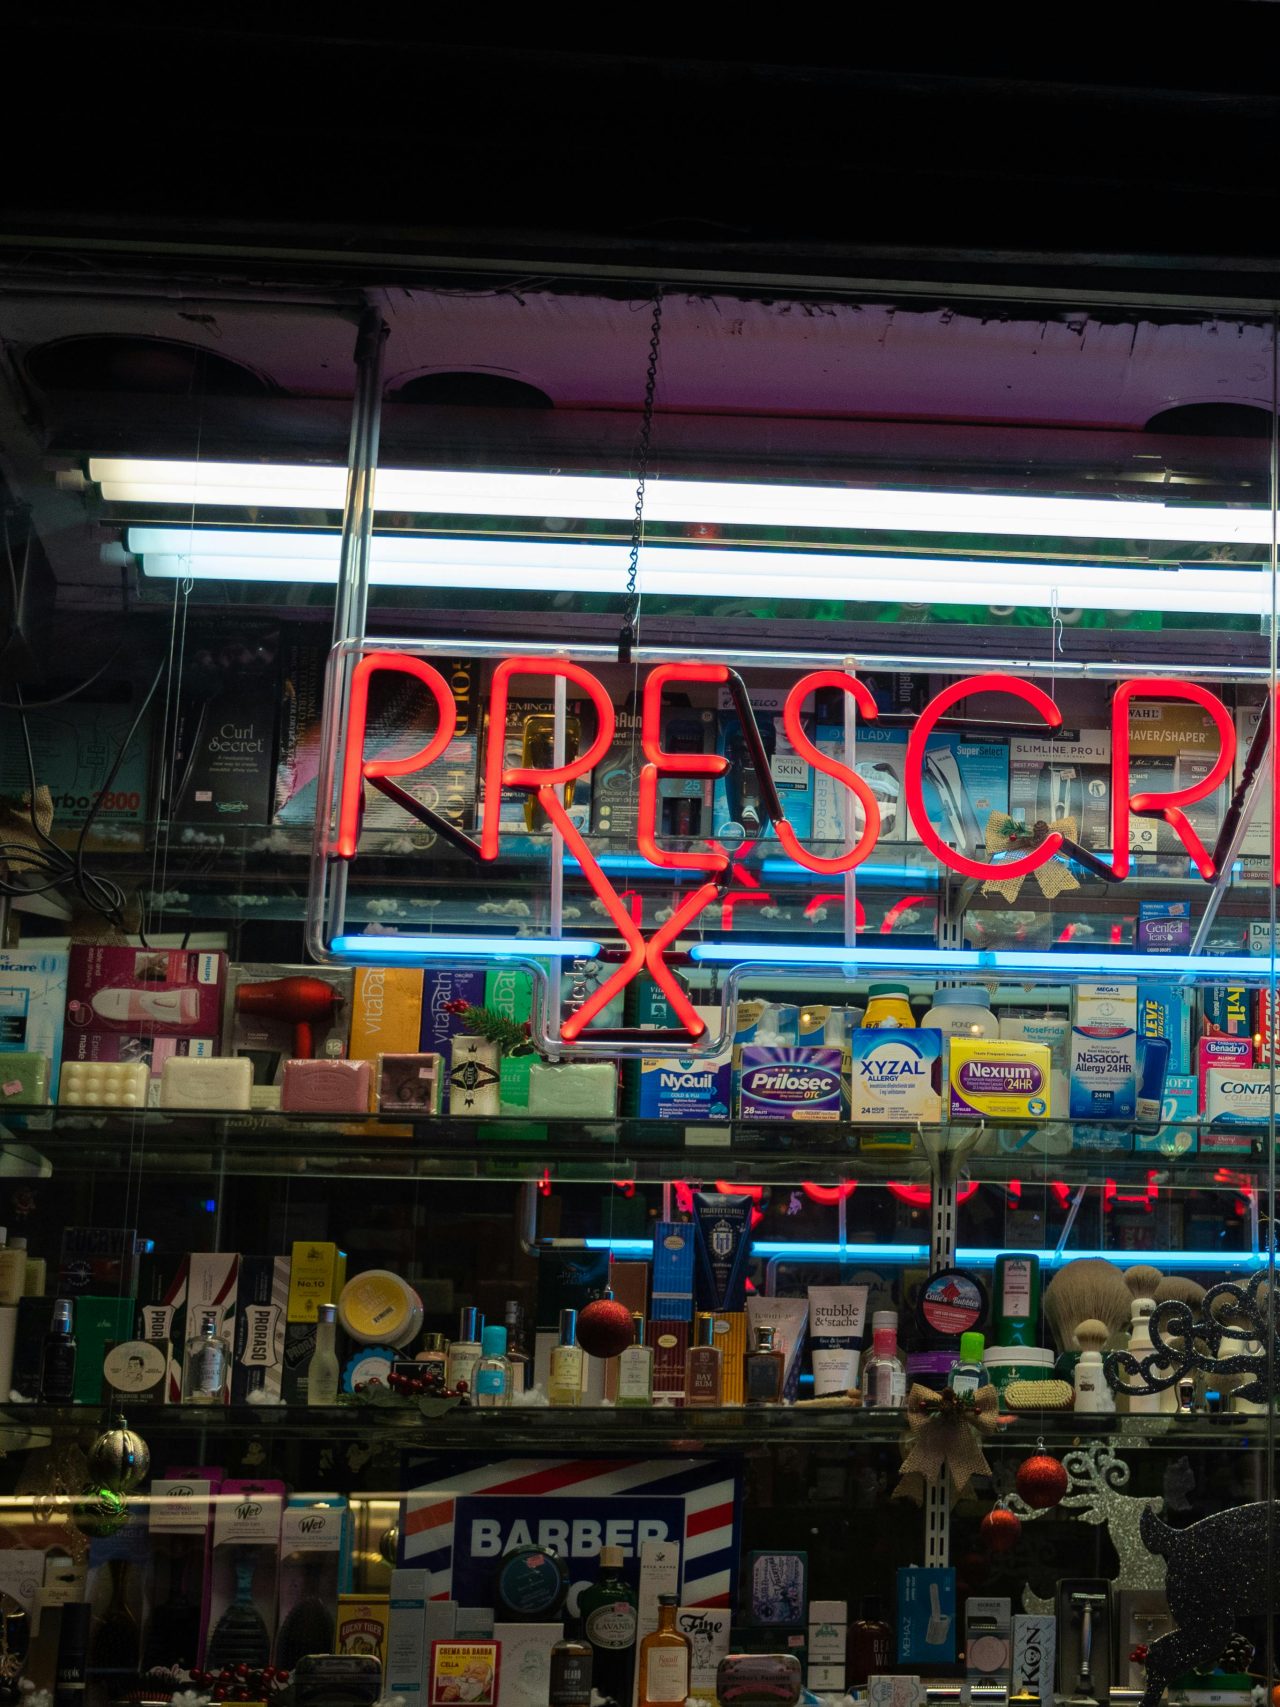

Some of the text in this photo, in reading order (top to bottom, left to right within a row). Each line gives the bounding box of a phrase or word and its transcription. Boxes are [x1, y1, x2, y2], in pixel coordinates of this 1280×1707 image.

[220, 724, 253, 739] Curl
[208, 736, 263, 753] Secret
[956, 744, 1003, 757] SuperSelect
[1016, 745, 1066, 755] SLIMLINE
[1071, 747, 1093, 755] PRO
[777, 765, 803, 775] SKIN
[1145, 921, 1184, 934] GenTeal
[1147, 933, 1168, 941] Tears
[203, 955, 213, 982] PHILIPS
[362, 967, 385, 1035] vitabat
[432, 970, 453, 1045] vitabath
[1023, 1025, 1065, 1035] NoseFrida
[79, 1034, 87, 1059] made
[327, 1041, 342, 1052] 12
[1209, 1044, 1247, 1053] Benadryl
[1077, 1052, 1129, 1064] Nasacort
[860, 1060, 926, 1075] XYZAL
[969, 1063, 1031, 1079] Nexium
[1075, 1063, 1106, 1074] Allergy
[660, 1074, 713, 1091] NyQuil
[751, 1074, 833, 1090] Prilosec
[1007, 1079, 1033, 1090] 24HR
[804, 1091, 820, 1099] OTC
[744, 1106, 755, 1114] 28
[298, 1280, 325, 1288] No.10
[816, 1305, 859, 1317] stubble
[251, 1309, 268, 1362] PRORASO
[696, 1373, 712, 1381] BAY
[695, 1379, 713, 1388] RUM
[239, 1505, 260, 1518] Wet
[302, 1517, 324, 1532] Wet
[470, 1519, 670, 1558] BARBER
[342, 1622, 383, 1634] LUCKY TIGER
[679, 1612, 723, 1640] Fine
[902, 1616, 912, 1657] MEHAZ
[440, 1648, 493, 1656] CREMA DA BARBA
[563, 1671, 582, 1681] BEARD
